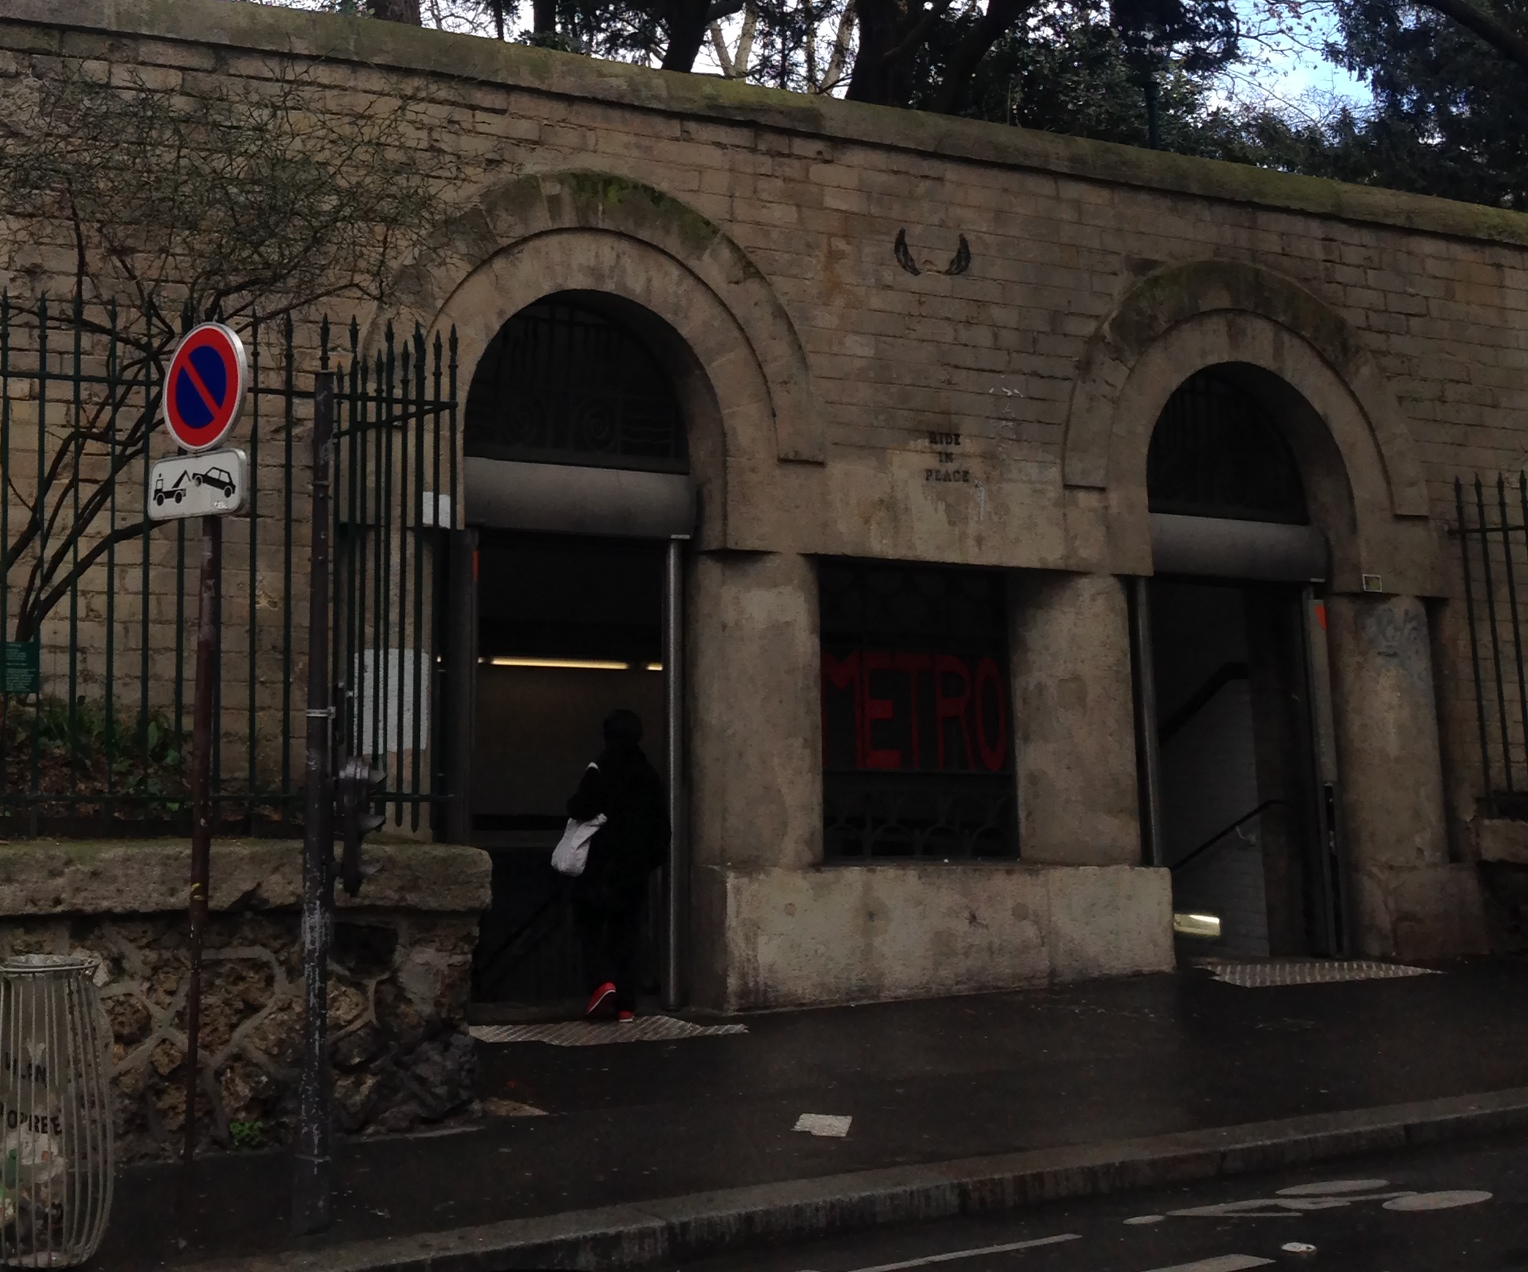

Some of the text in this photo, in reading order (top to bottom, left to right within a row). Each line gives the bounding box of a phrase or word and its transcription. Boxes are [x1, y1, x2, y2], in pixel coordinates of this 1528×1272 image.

[929, 432, 961, 446] RIDE
[938, 451, 954, 463] IN
[925, 468, 970, 483] PEACE
[821, 649, 1008, 772] METRO
